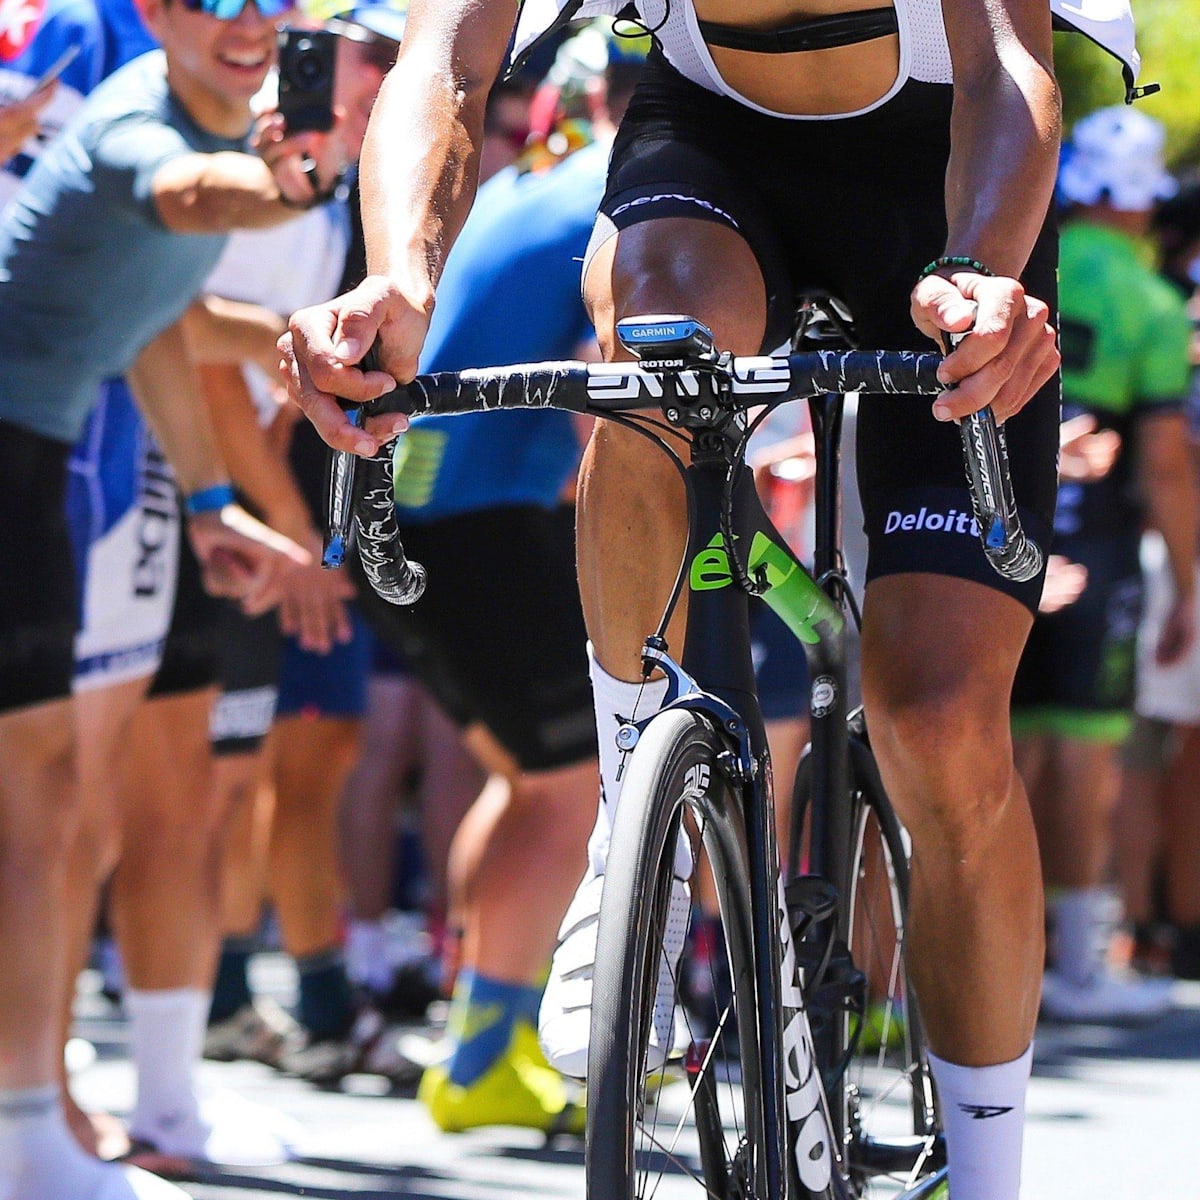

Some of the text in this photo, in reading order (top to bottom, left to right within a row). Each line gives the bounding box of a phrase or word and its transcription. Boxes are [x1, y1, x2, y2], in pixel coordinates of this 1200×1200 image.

[632, 326, 676, 338] GARMIN
[639, 359, 684, 369] ROTOR
[884, 507, 981, 537] Deloitt
